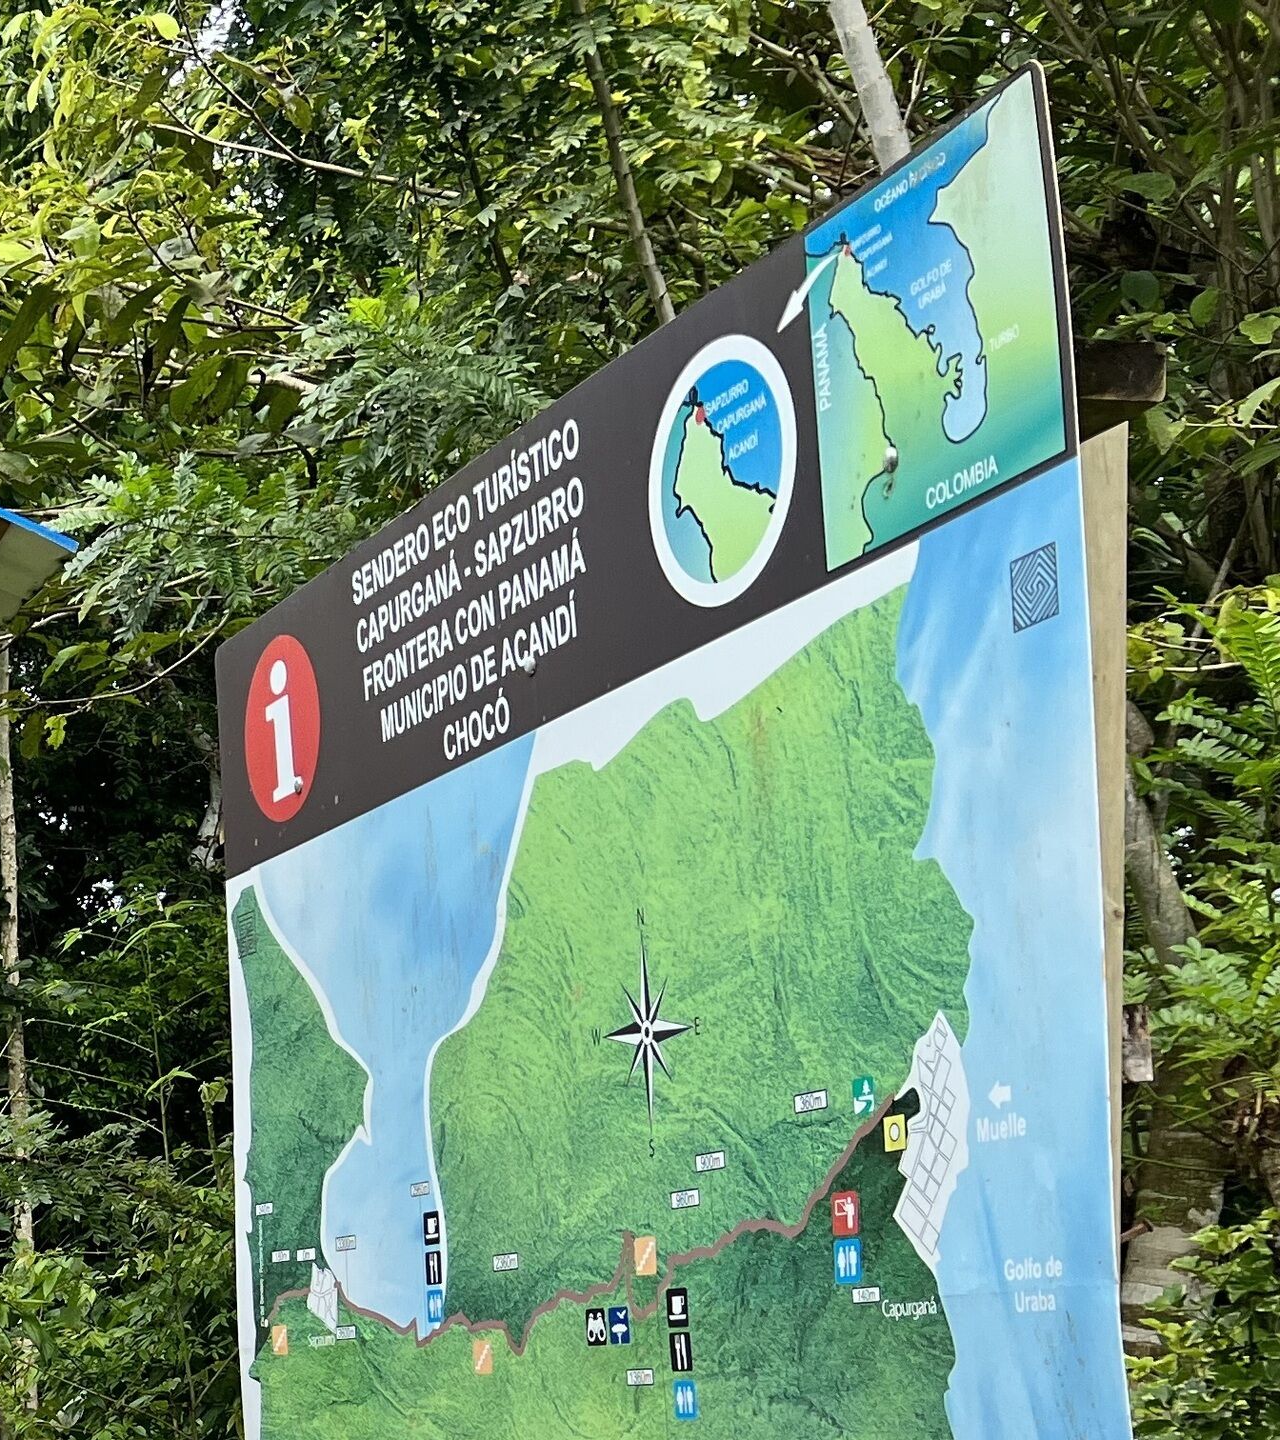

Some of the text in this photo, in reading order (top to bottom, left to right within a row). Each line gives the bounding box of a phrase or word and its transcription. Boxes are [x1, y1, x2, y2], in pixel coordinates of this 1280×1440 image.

[910, 259, 952, 296] GOLFO DE
[989, 324, 1020, 353] TURBO
[705, 378, 749, 415] SAPZURRO
[926, 454, 999, 510] COLOMBIA
[352, 419, 579, 605] SENDERO ECO TURÍSTICO
[357, 549, 462, 653] CAPURGANÁ
[474, 477, 584, 578] SAPZURRO
[362, 527, 587, 701] FRONTERA CON PANAMÁ
[380, 589, 578, 743] MUNICIPIO DE ACANDÍ
[443, 687, 510, 761] CHOCÓ
[636, 907, 645, 926] N
[591, 1027, 601, 1047] W
[694, 1016, 701, 1036] E
[976, 1113, 1026, 1142] Muelle
[648, 1138, 655, 1158] S
[1004, 1255, 1063, 1280] Golfo de
[881, 1295, 937, 1321] Capurganá
[1015, 1291, 1056, 1313] Uraba
